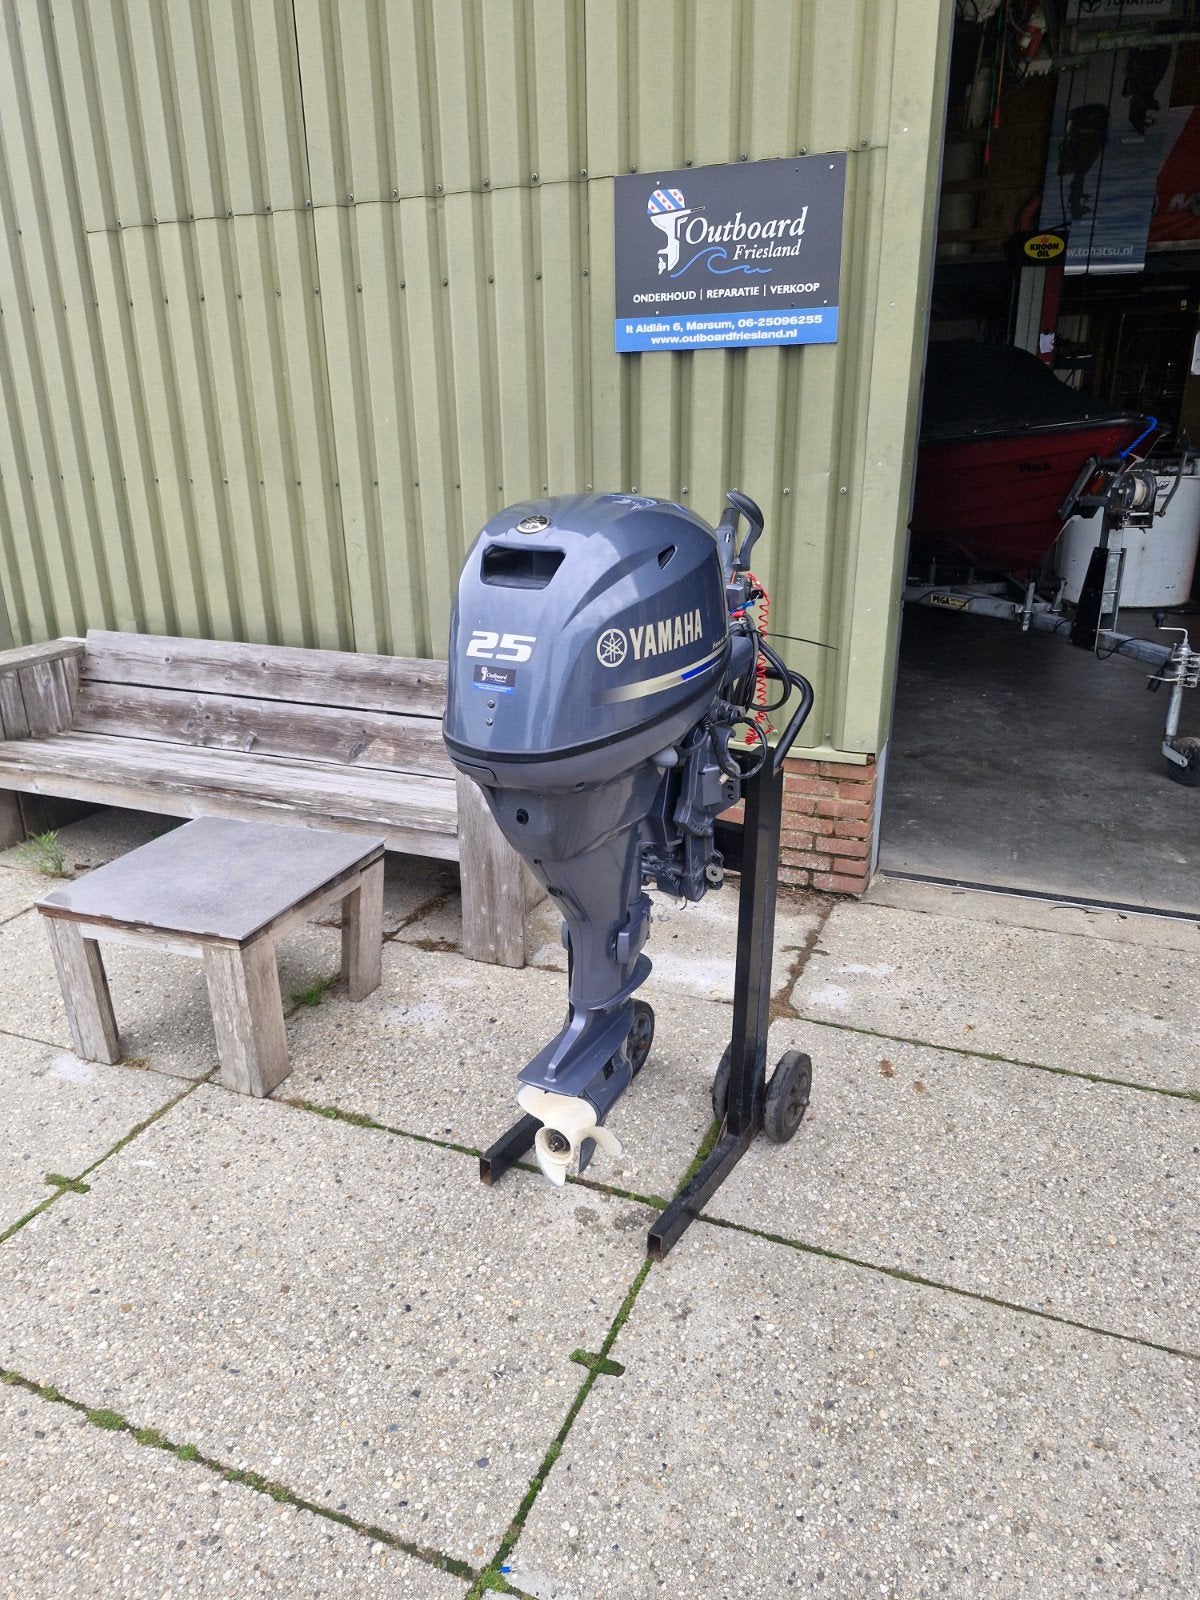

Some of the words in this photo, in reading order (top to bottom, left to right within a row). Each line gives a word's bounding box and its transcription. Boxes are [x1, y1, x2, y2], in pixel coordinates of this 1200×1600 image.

[685, 205, 809, 245] Outboard
[732, 239, 802, 261] Friesland
[1029, 242, 1059, 251] KROON
[1037, 250, 1050, 258] OIL
[632, 290, 697, 303] ONDERHOUD
[706, 286, 760, 299] REPARATIE
[770, 282, 821, 295] VERKOOP
[672, 322, 684, 333] 6,
[686, 321, 735, 331] Marsum,
[737, 314, 823, 328] 06-25096255
[651, 328, 798, 344] www.outboardfriesland.nl
[932, 595, 950, 605] PEGA
[628, 609, 703, 661] YAMAHA
[466, 631, 537, 663] 25
